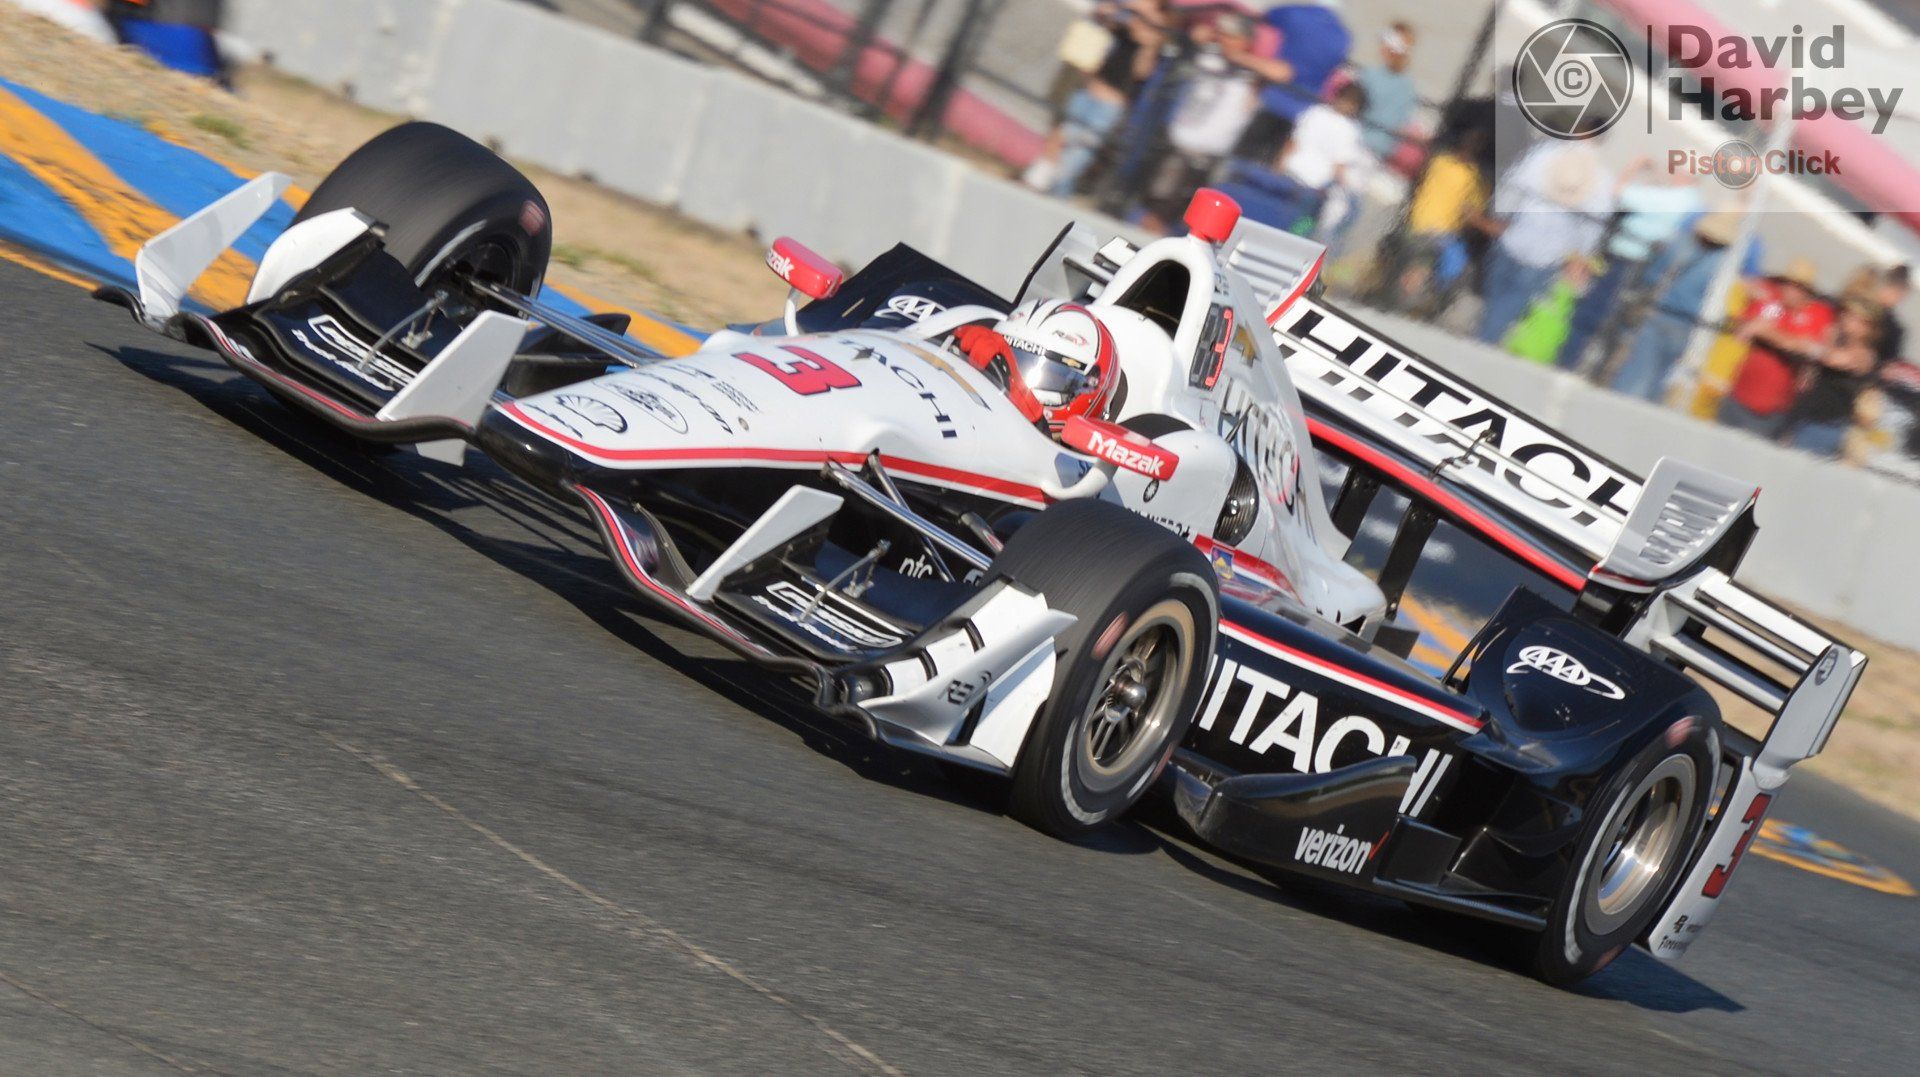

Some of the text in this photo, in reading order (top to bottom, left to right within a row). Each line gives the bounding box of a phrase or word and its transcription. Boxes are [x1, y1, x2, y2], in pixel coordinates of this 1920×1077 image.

[731, 345, 863, 396] 3
[1087, 430, 1165, 476] Mazak
[1279, 309, 1631, 527] HITACH
[1191, 653, 1453, 818] ITACHI
[1294, 824, 1372, 875] verizon
[1701, 793, 1773, 899] 3
